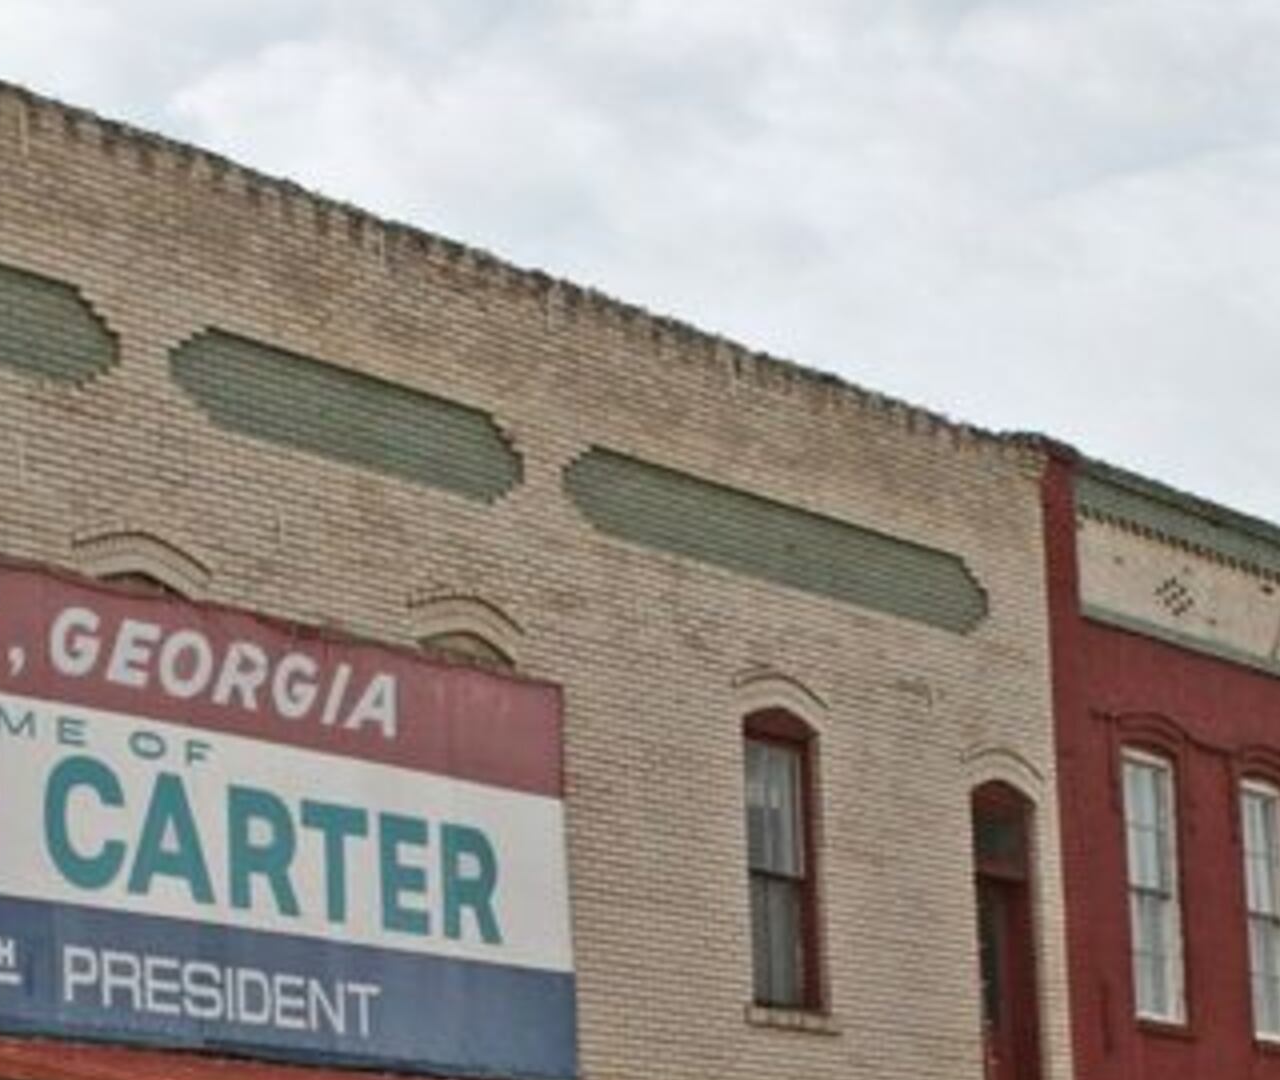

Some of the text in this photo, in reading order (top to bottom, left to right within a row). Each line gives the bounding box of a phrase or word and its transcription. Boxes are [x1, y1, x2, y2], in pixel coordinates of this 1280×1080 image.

[49, 606, 399, 738] GEORGIA
[128, 729, 213, 766] OF
[43, 753, 505, 945] CARTER
[62, 942, 382, 1039] PRESIDENT
